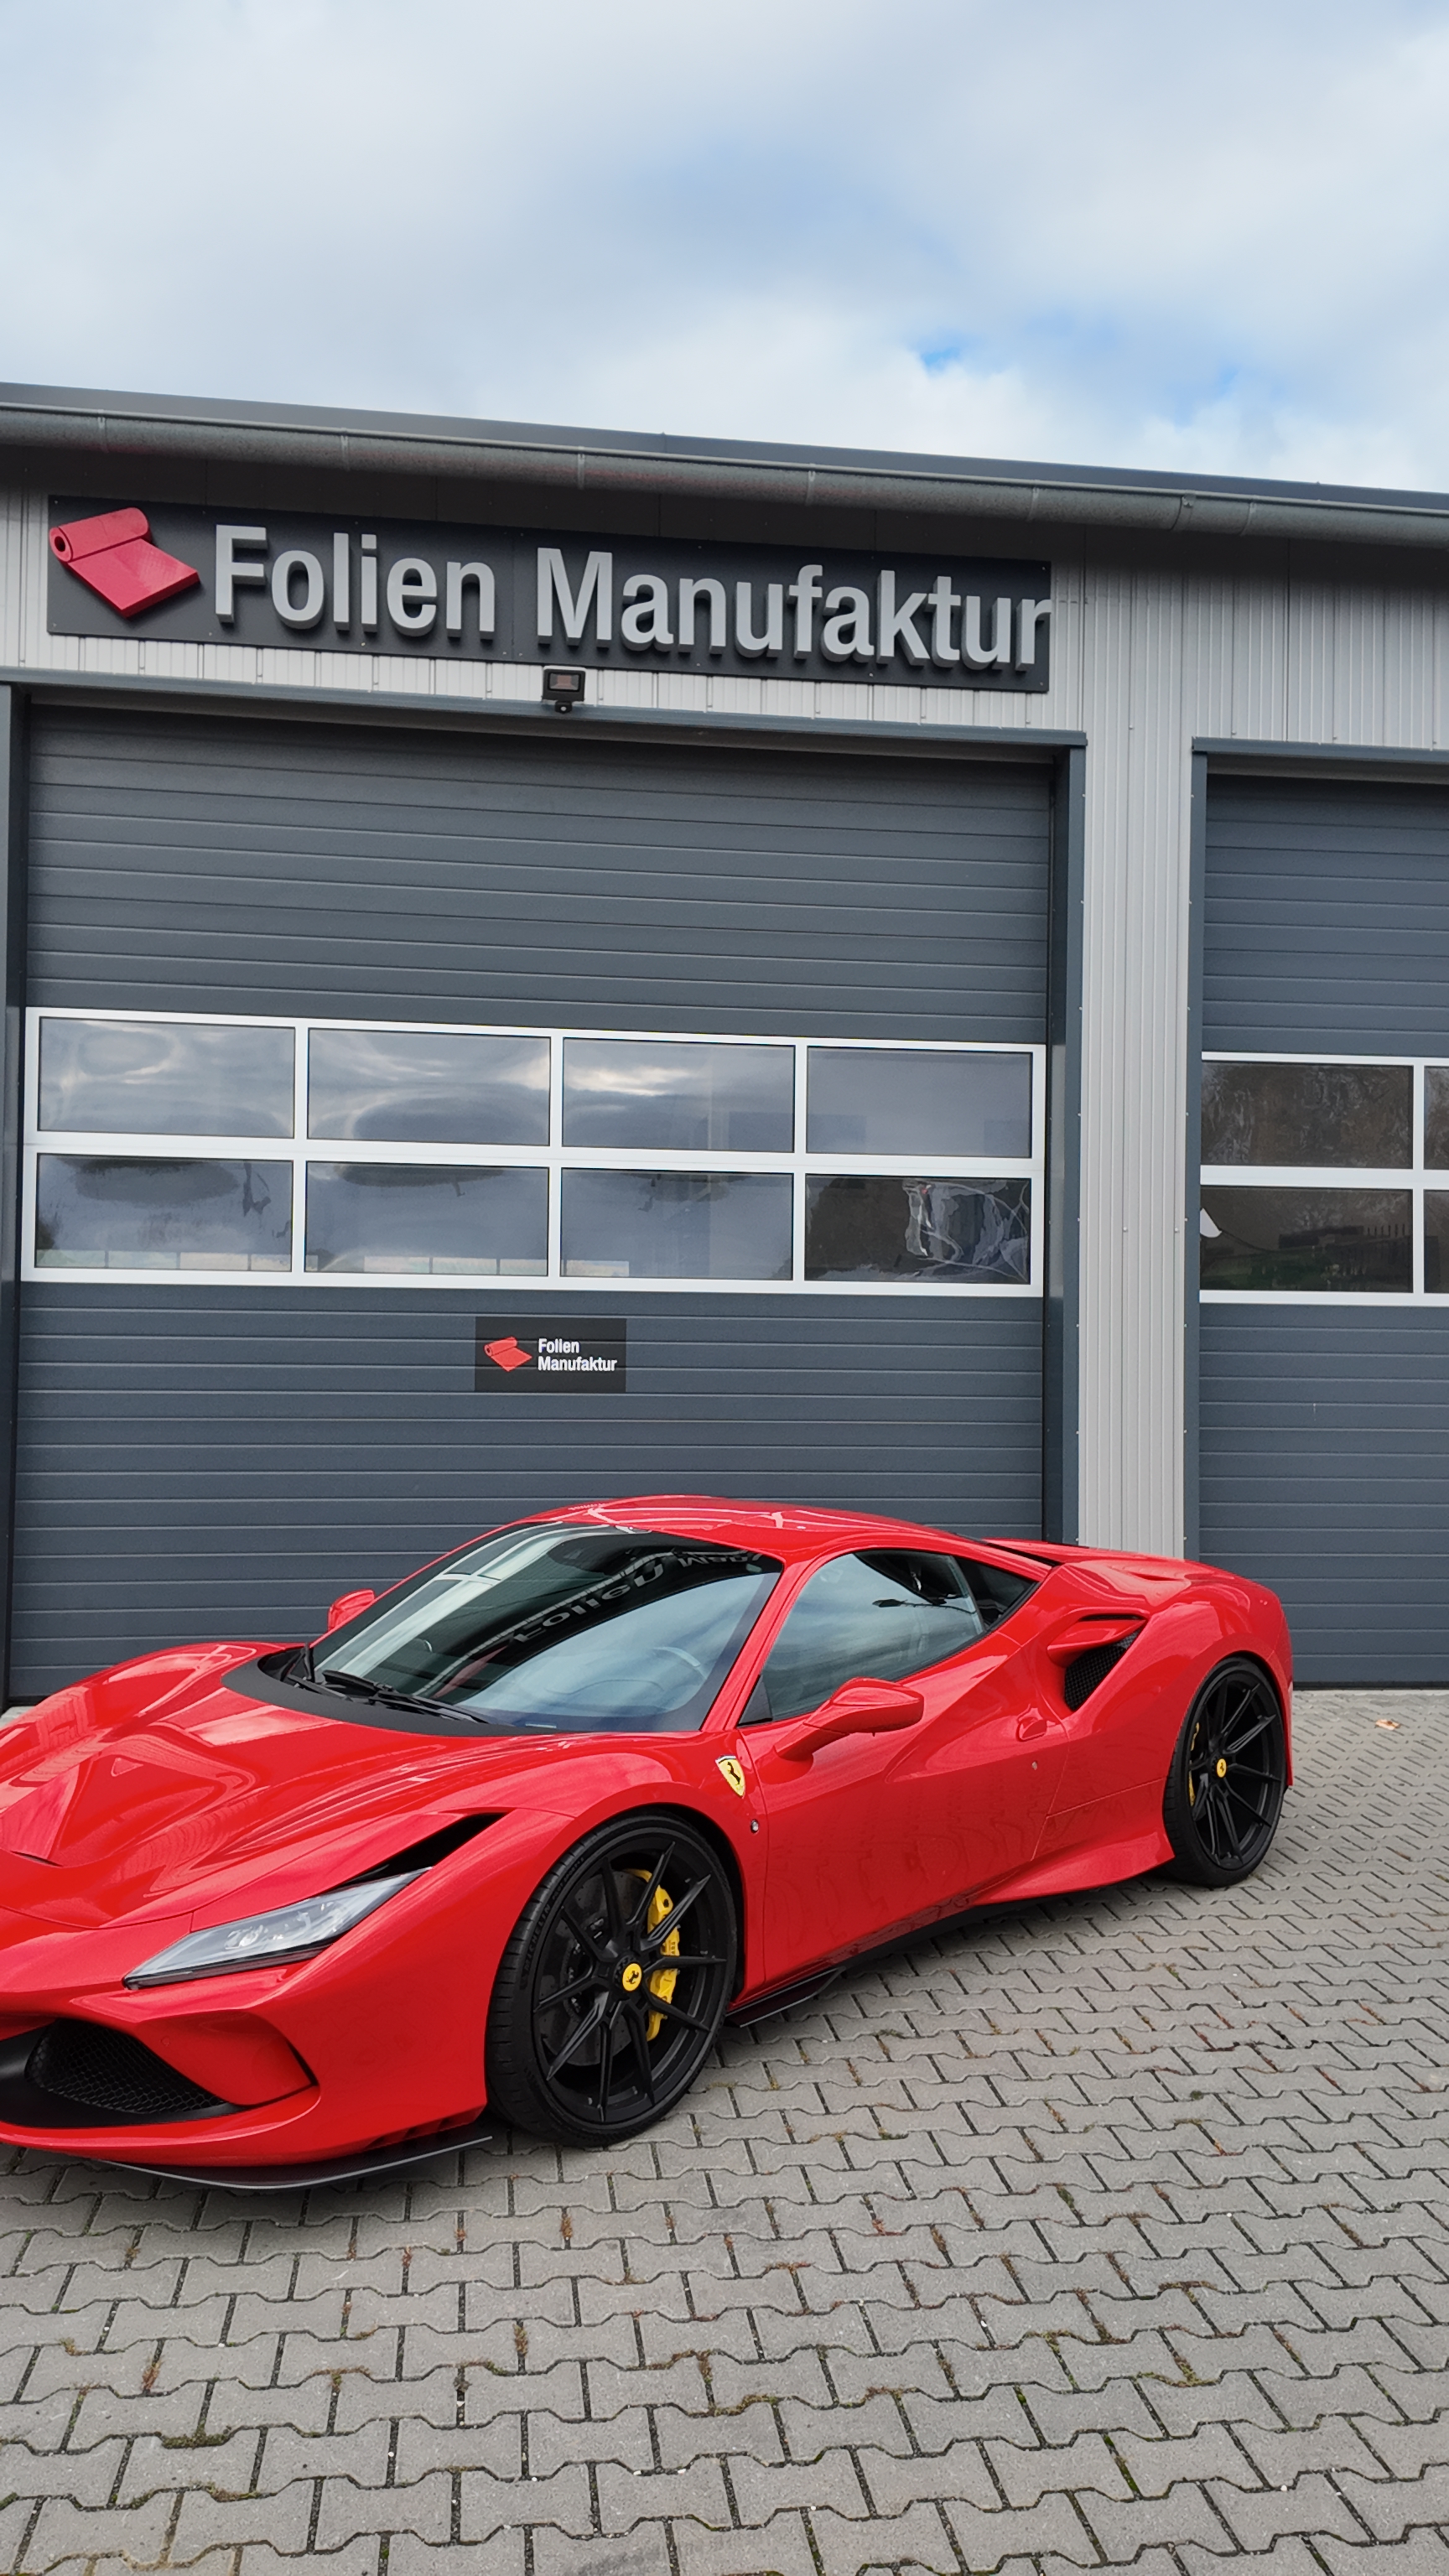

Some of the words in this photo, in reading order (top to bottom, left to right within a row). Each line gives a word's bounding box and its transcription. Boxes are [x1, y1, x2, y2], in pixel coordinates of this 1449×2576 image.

[216, 524, 496, 640] Folien
[538, 548, 1052, 670] Manufaktur
[538, 1338, 580, 1353] Folien
[538, 1356, 618, 1372] Manufaktur
